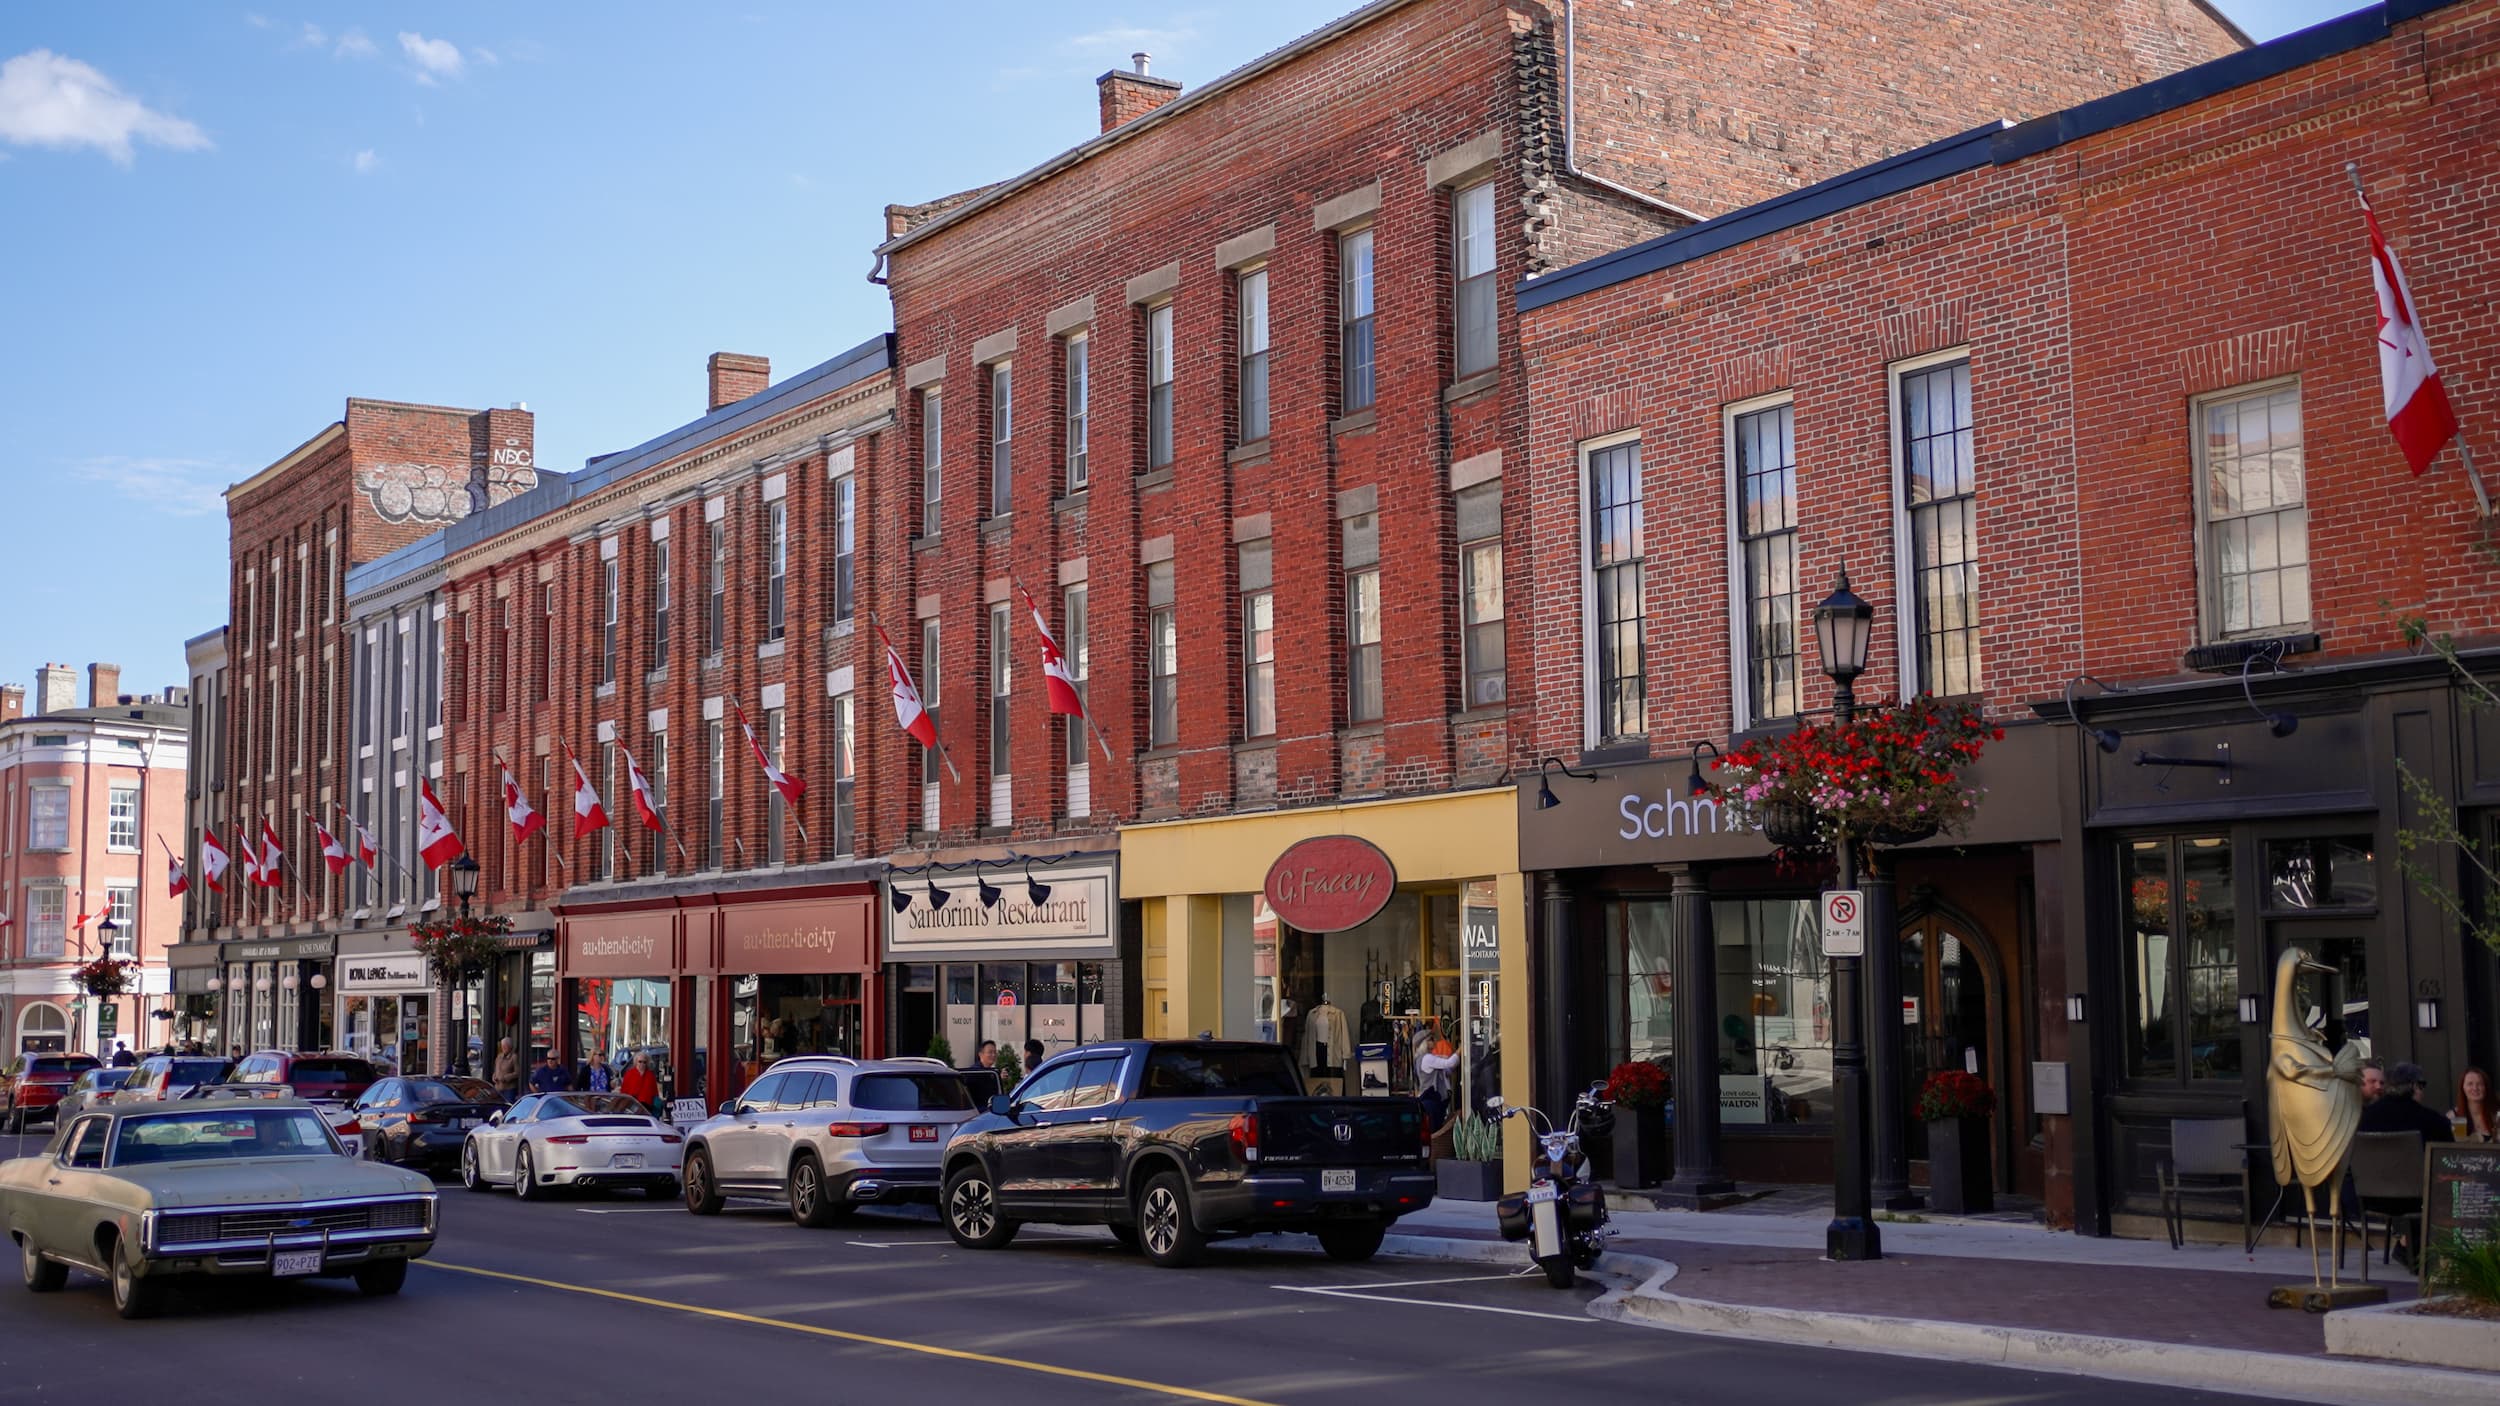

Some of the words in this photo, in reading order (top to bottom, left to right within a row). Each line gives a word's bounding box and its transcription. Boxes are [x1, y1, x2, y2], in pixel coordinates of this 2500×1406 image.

[997, 897, 1087, 926] Restaurant
[1826, 928, 1831, 937] 2
[1846, 928, 1851, 937] 7
[349, 967, 366, 980] ROYAL
[1720, 1099, 1759, 1108] WALTON
